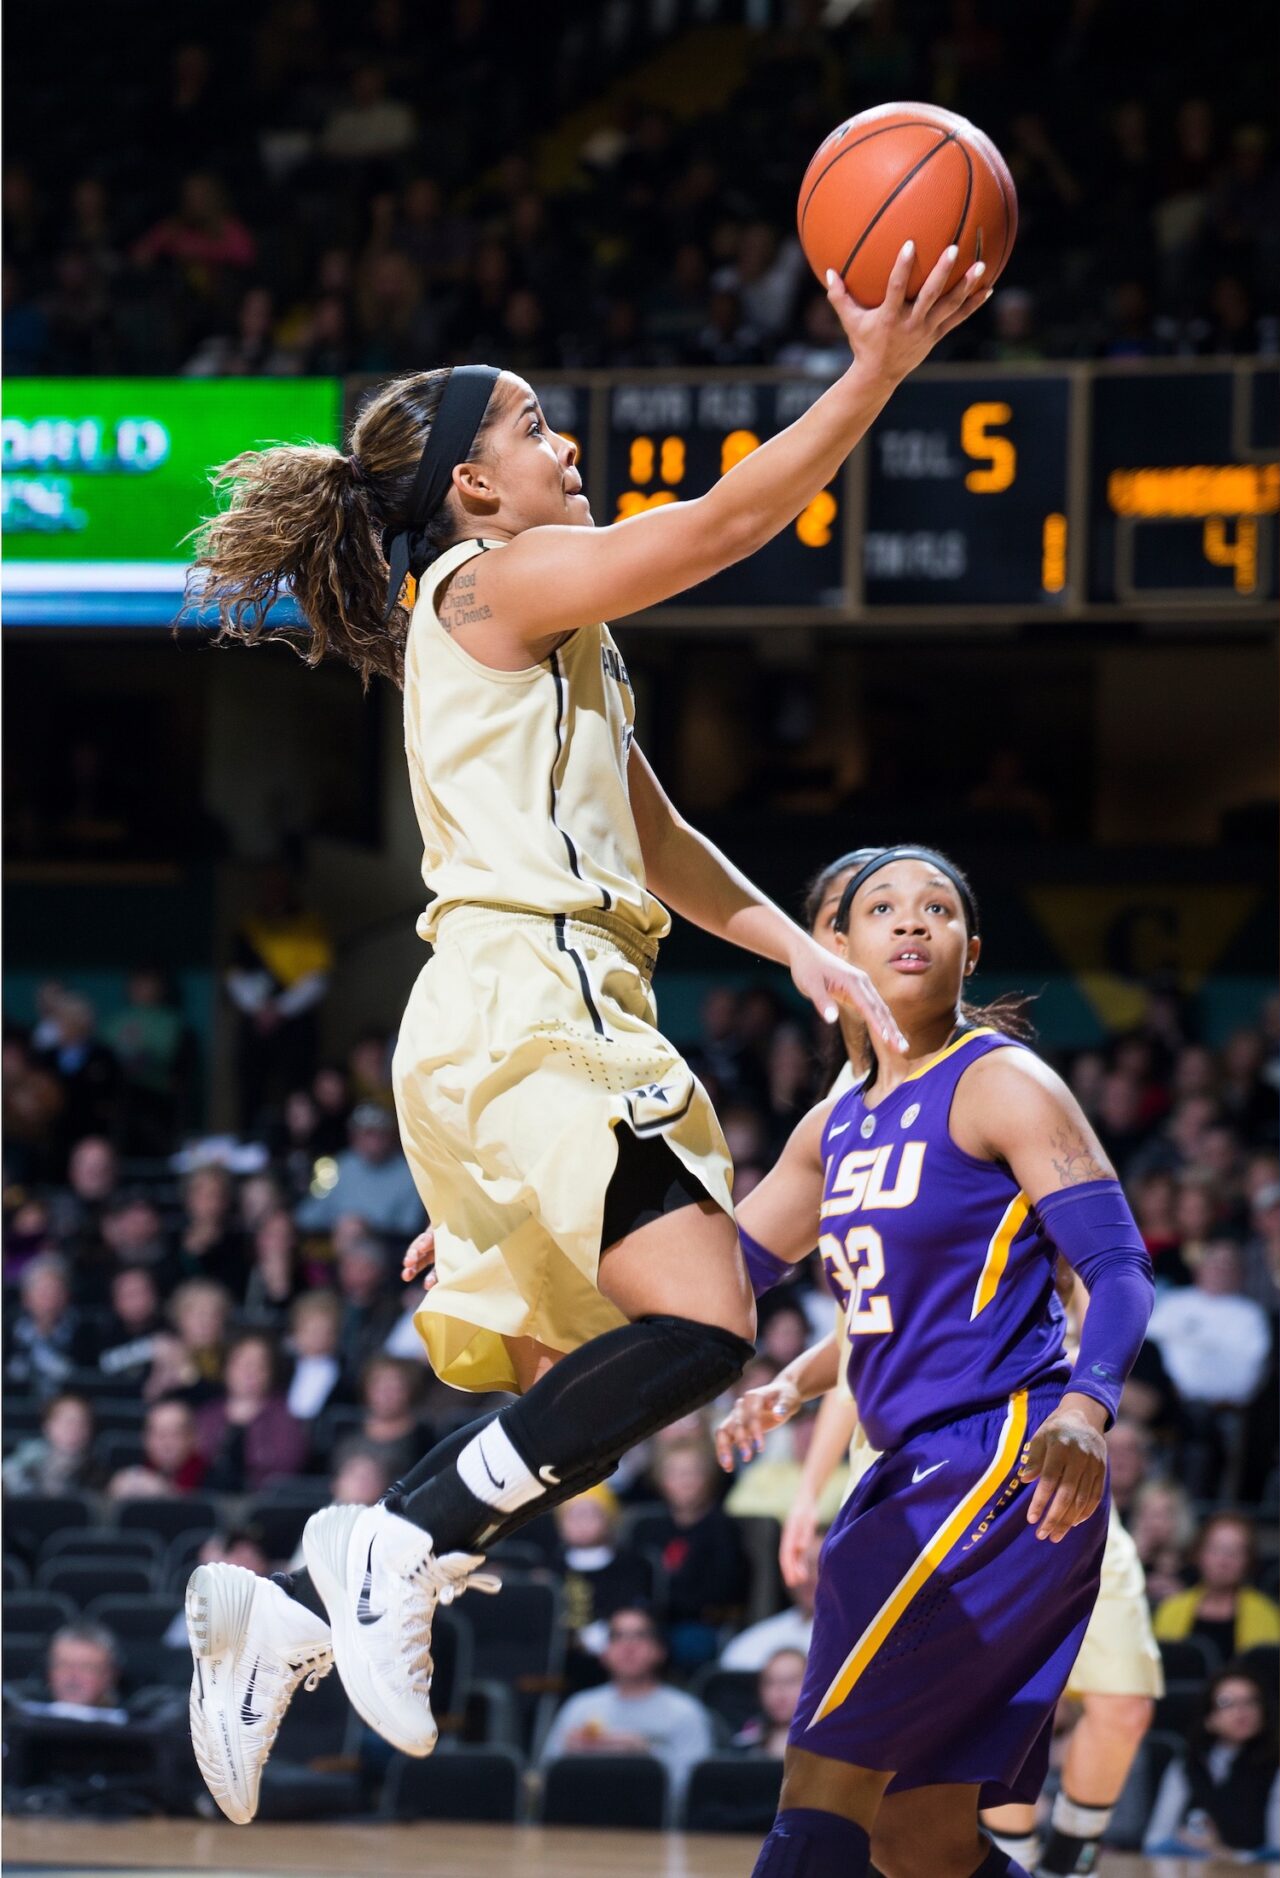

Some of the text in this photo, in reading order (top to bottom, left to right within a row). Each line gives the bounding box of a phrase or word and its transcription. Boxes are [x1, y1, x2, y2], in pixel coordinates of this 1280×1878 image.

[961, 402, 1016, 494] 5
[1042, 512, 1067, 593] 1
[1203, 514, 1257, 596] 4
[455, 605, 492, 626] Choice
[819, 1141, 928, 1222] LSU
[818, 1224, 894, 1336] 32
[961, 1509, 997, 1551] LADY
